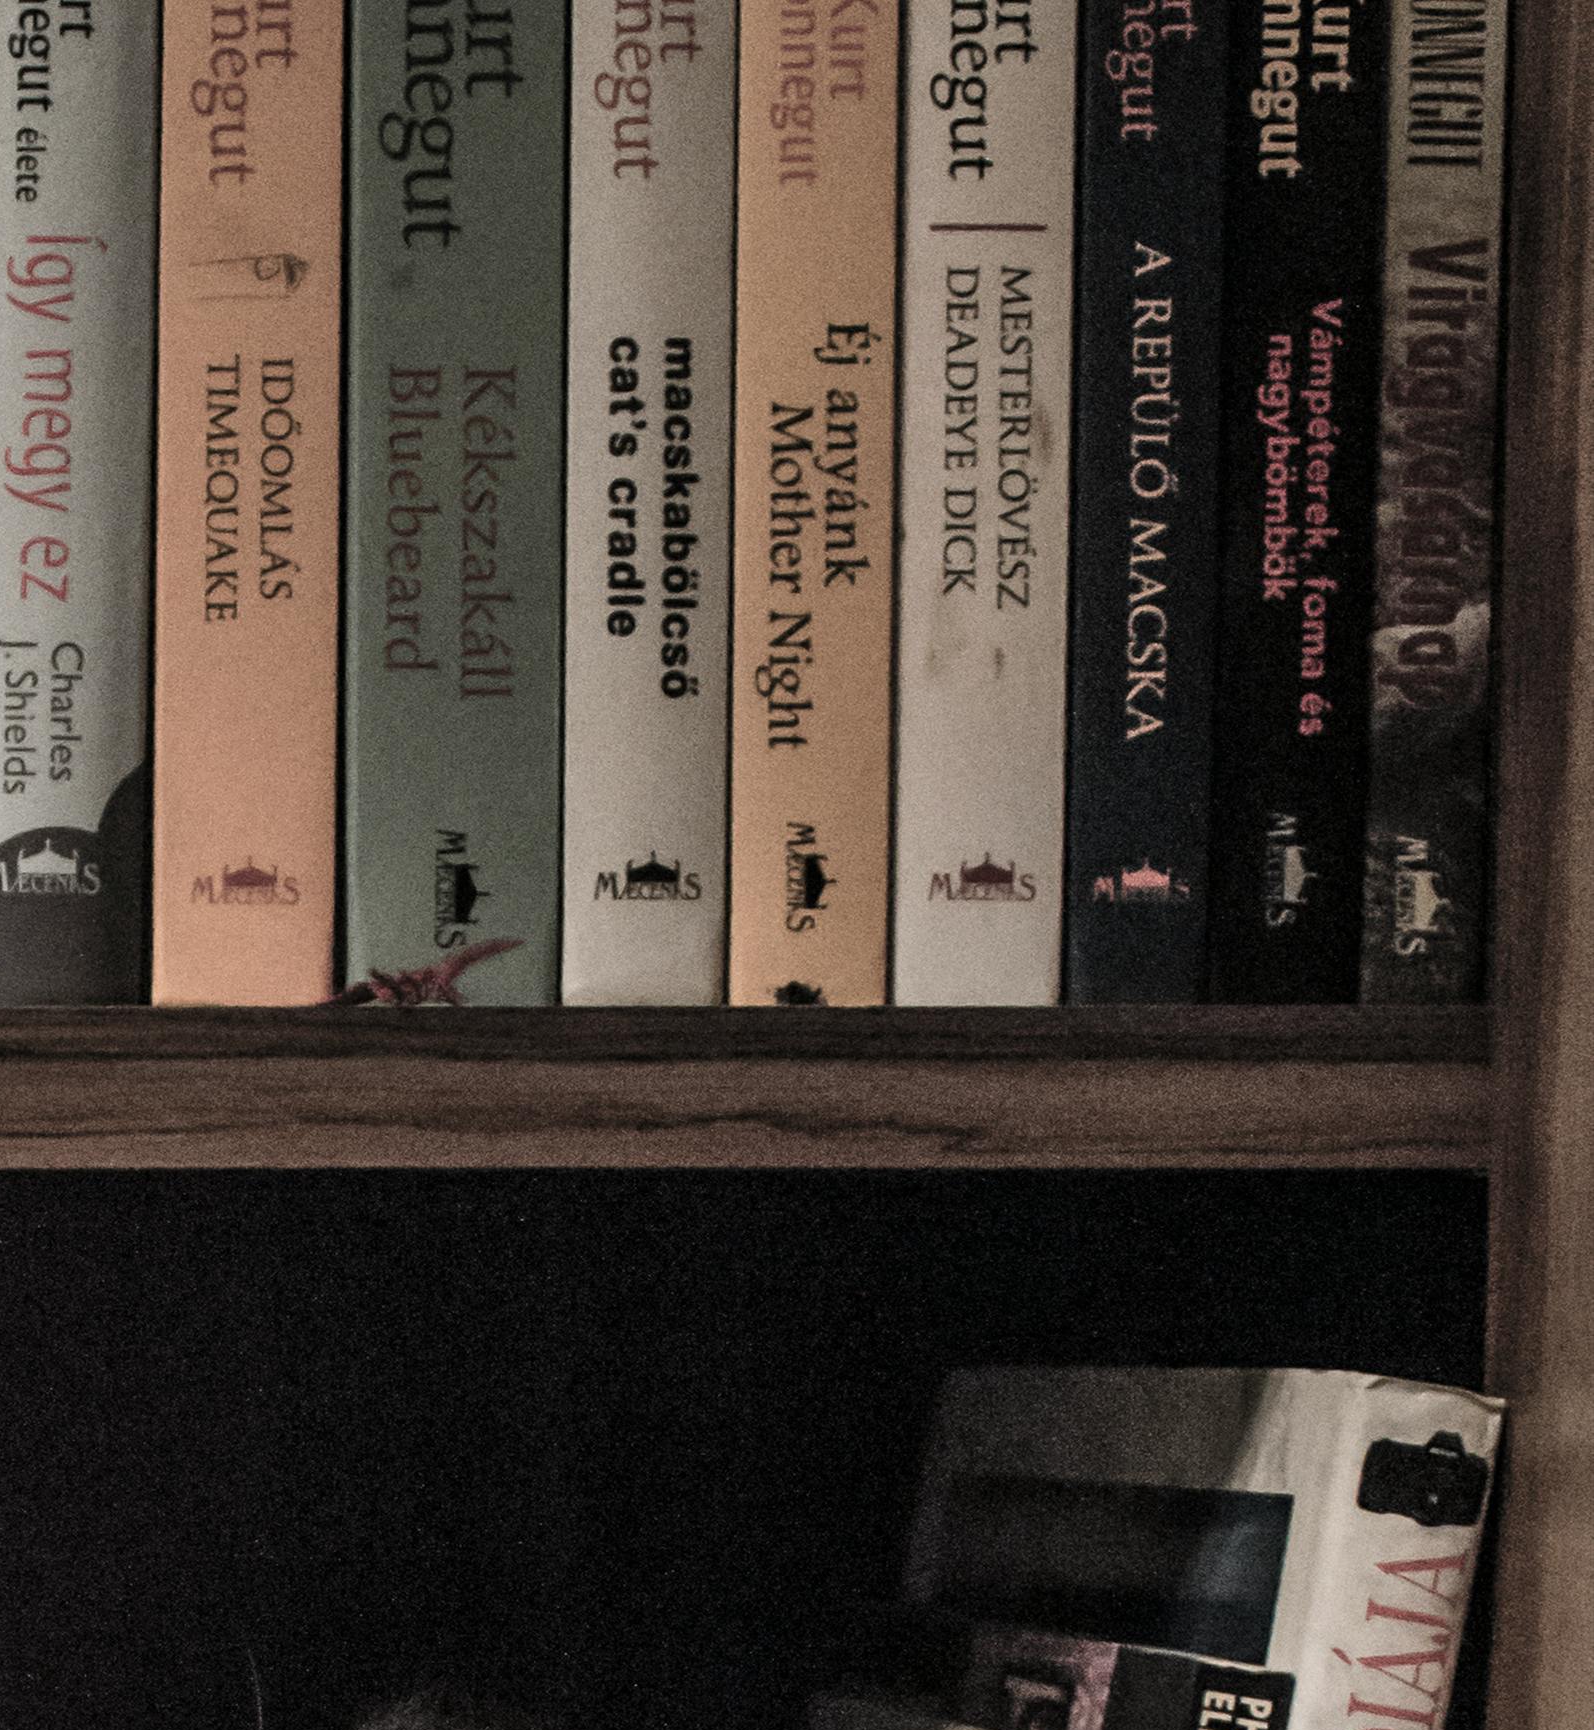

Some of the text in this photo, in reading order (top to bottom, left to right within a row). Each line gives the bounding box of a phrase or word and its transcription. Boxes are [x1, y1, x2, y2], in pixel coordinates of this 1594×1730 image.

[3, 233, 109, 603] Így megy ez
[202, 352, 242, 624] TIMEQUAKE
[258, 356, 304, 601] IDŐOMLÁS
[384, 366, 444, 674] Bluebeard
[459, 364, 519, 701] Kékszakáll
[606, 336, 649, 638] cat's cradle
[660, 336, 700, 701] macskabölcső
[754, 400, 818, 750] Mother Night
[811, 321, 883, 588] Éj anyánk
[940, 264, 982, 597] DEADEYE DICK
[995, 264, 1040, 611] MESTERLÖVÉSZ
[1124, 239, 1182, 741] A REPÜLŐ MACSKA
[1297, 298, 1344, 738] Vámpéterek, foma és
[3, 669, 40, 796] Shields
[49, 641, 87, 783] Charles
